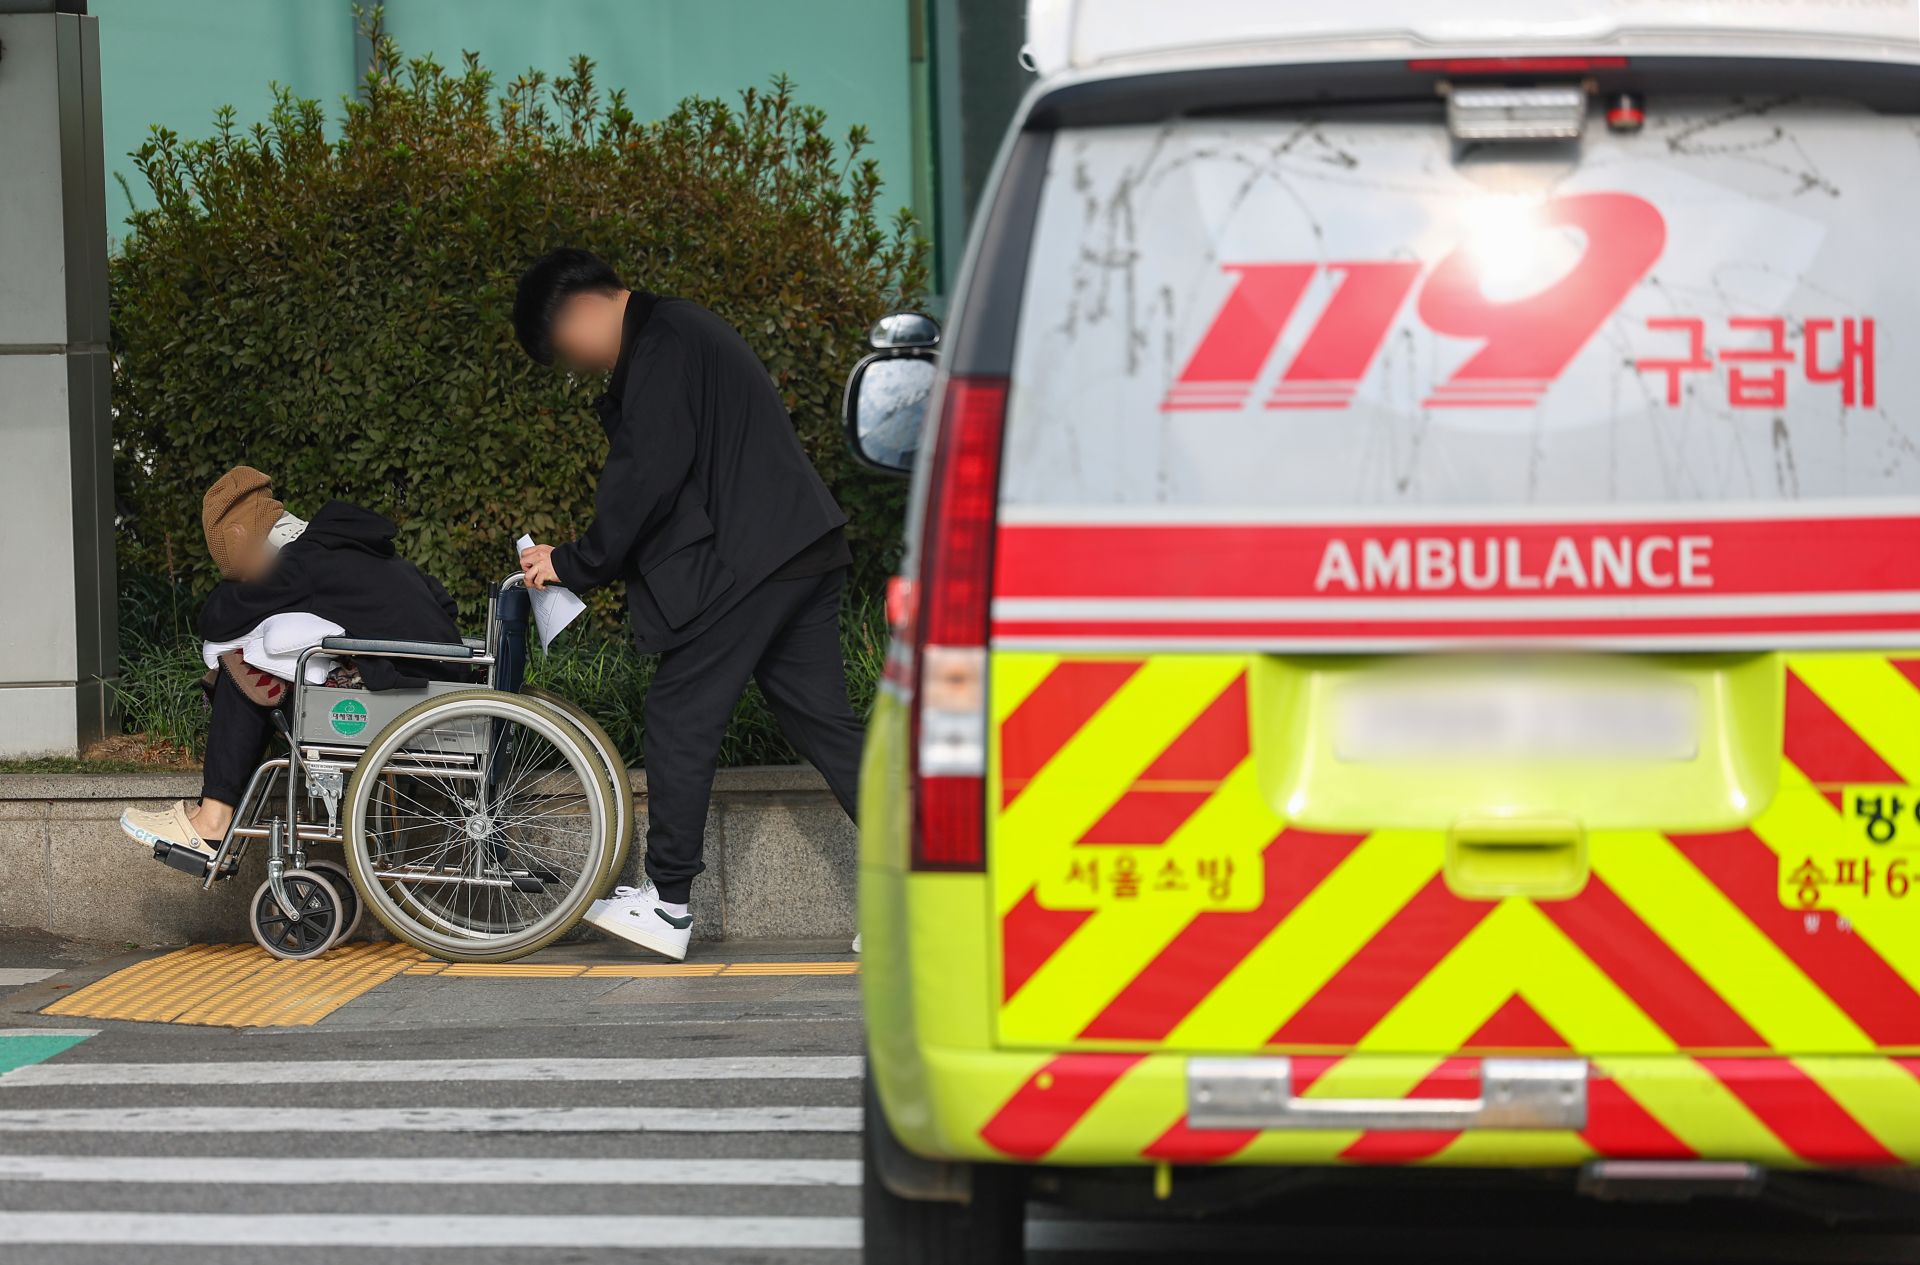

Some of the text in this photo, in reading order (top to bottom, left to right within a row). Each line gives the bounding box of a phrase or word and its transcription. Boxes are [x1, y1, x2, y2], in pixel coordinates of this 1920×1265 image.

[1160, 191, 1876, 411] 119 구급대
[1314, 536, 1714, 591] AMBULANCE
[1856, 796, 1920, 844] 방
